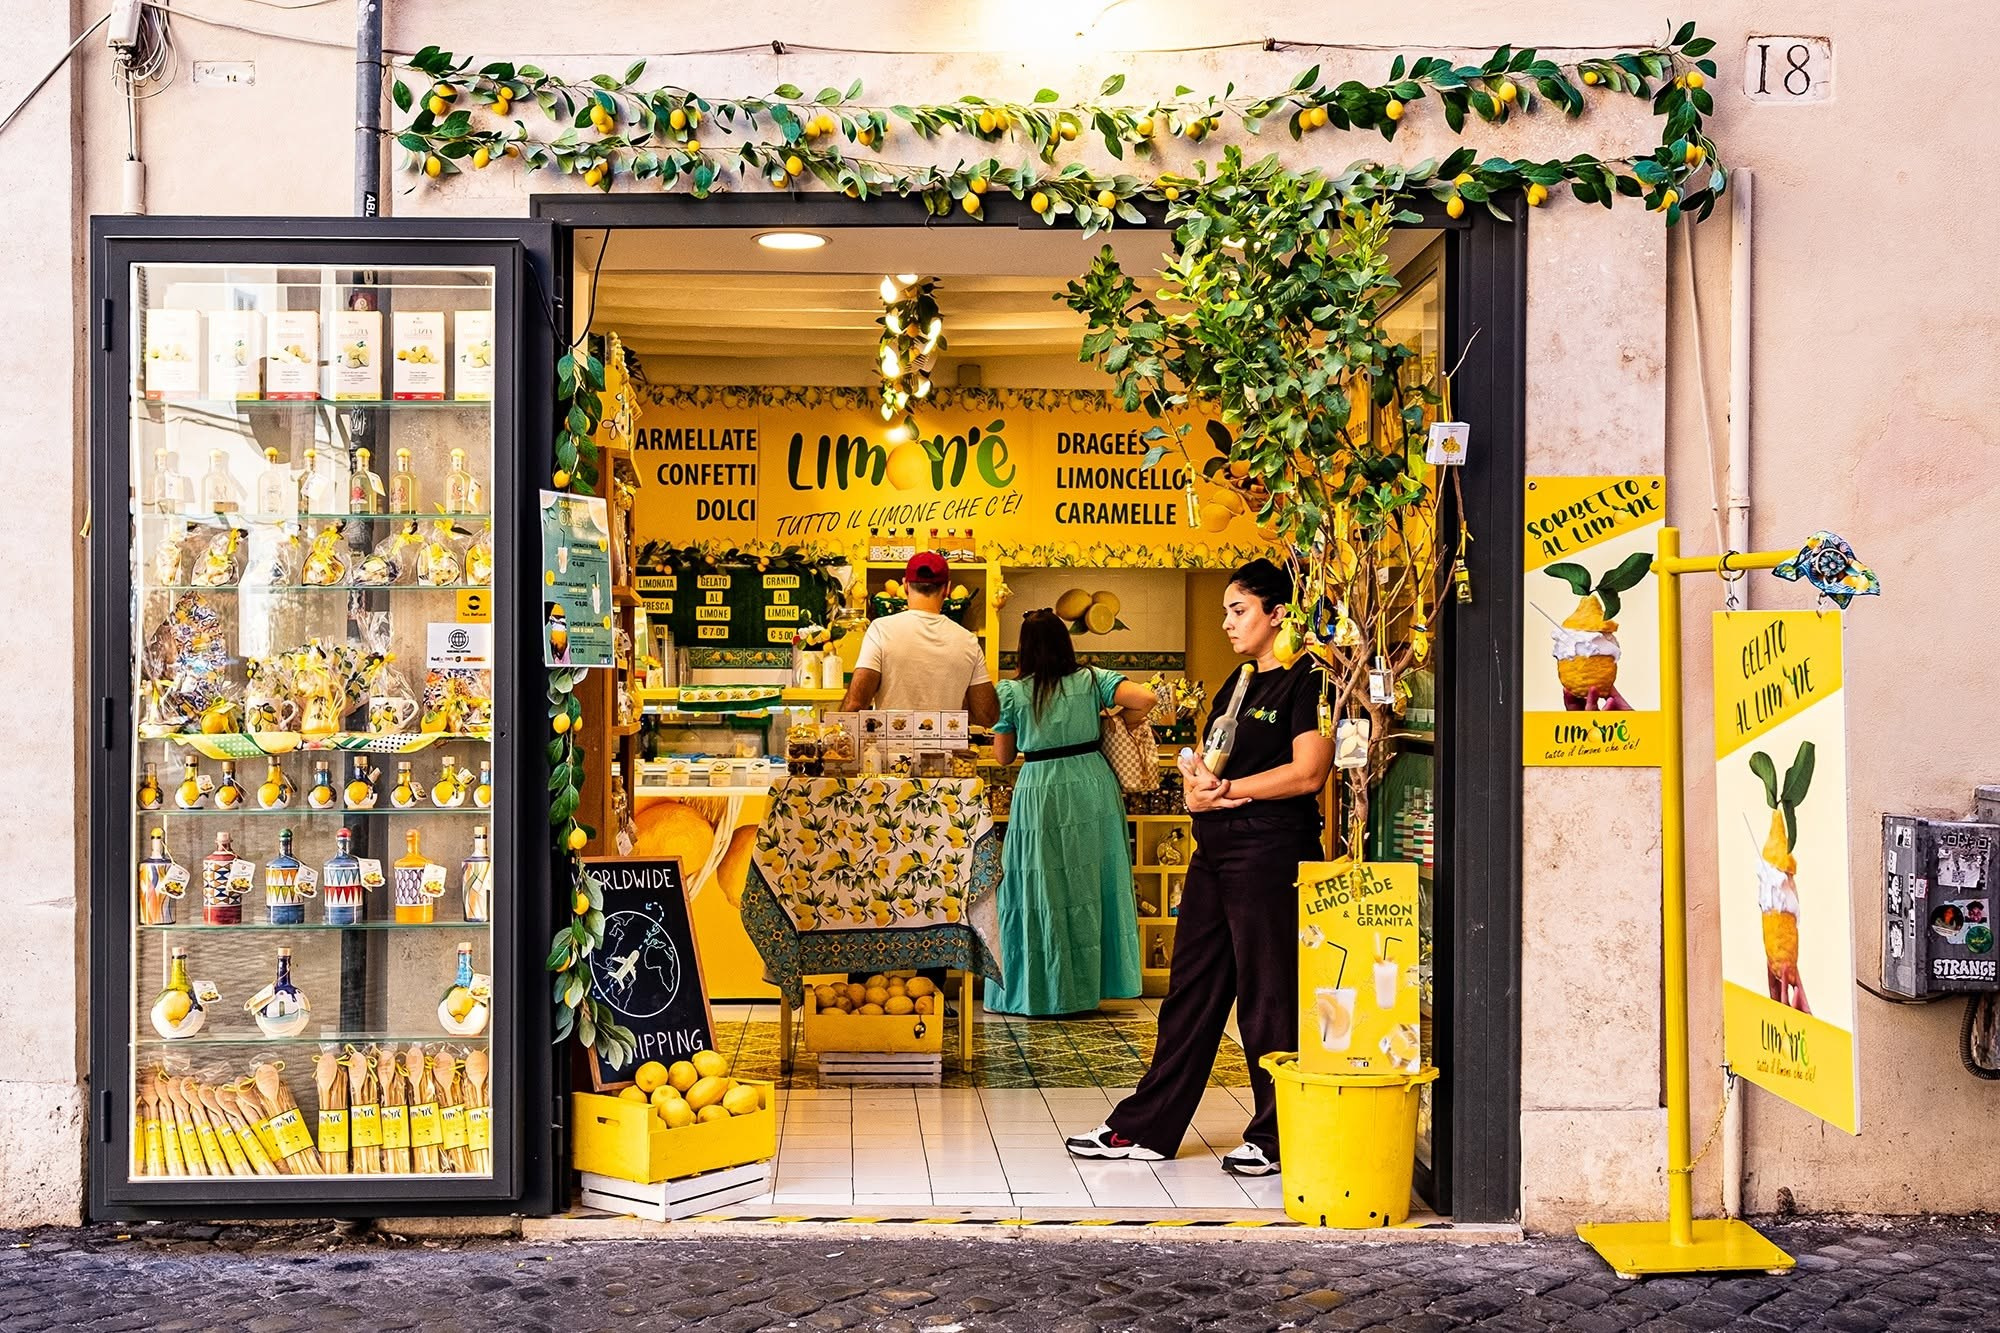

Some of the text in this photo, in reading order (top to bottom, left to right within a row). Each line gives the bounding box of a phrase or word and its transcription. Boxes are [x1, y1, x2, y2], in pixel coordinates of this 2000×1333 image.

[1754, 44, 1811, 95] 18
[635, 428, 757, 451] ARMELLATE
[657, 463, 756, 486] CONFETTI
[1057, 467, 1186, 490] LIMONCELLO
[697, 499, 756, 521] DOLCI
[776, 511, 841, 537] TUTTO
[846, 509, 863, 528] IL
[867, 501, 941, 527] LIMONE
[943, 496, 983, 519] CHE
[1055, 502, 1176, 525] CARAMELLE
[1527, 480, 1639, 540] SORBETTO
[1542, 493, 1660, 559] AL LIMONE
[638, 577, 674, 589] LIMONATA
[700, 577, 728, 588] GELATO
[766, 575, 797, 586] GRANITA
[643, 601, 670, 611] FRESCA
[709, 593, 719, 602] AL
[777, 592, 787, 602] AL
[700, 608, 728, 619] LIMONE
[768, 608, 796, 618] LIMONE
[1742, 620, 1787, 679] GELATO
[1736, 657, 1815, 736] AL LIMONE
[1306, 878, 1393, 915] LEMOADE
[1342, 904, 1412, 918] & LEMON
[1357, 917, 1414, 927] GRANITA
[1933, 958, 1997, 977] STRANGE
[633, 1029, 704, 1060] IPPING
